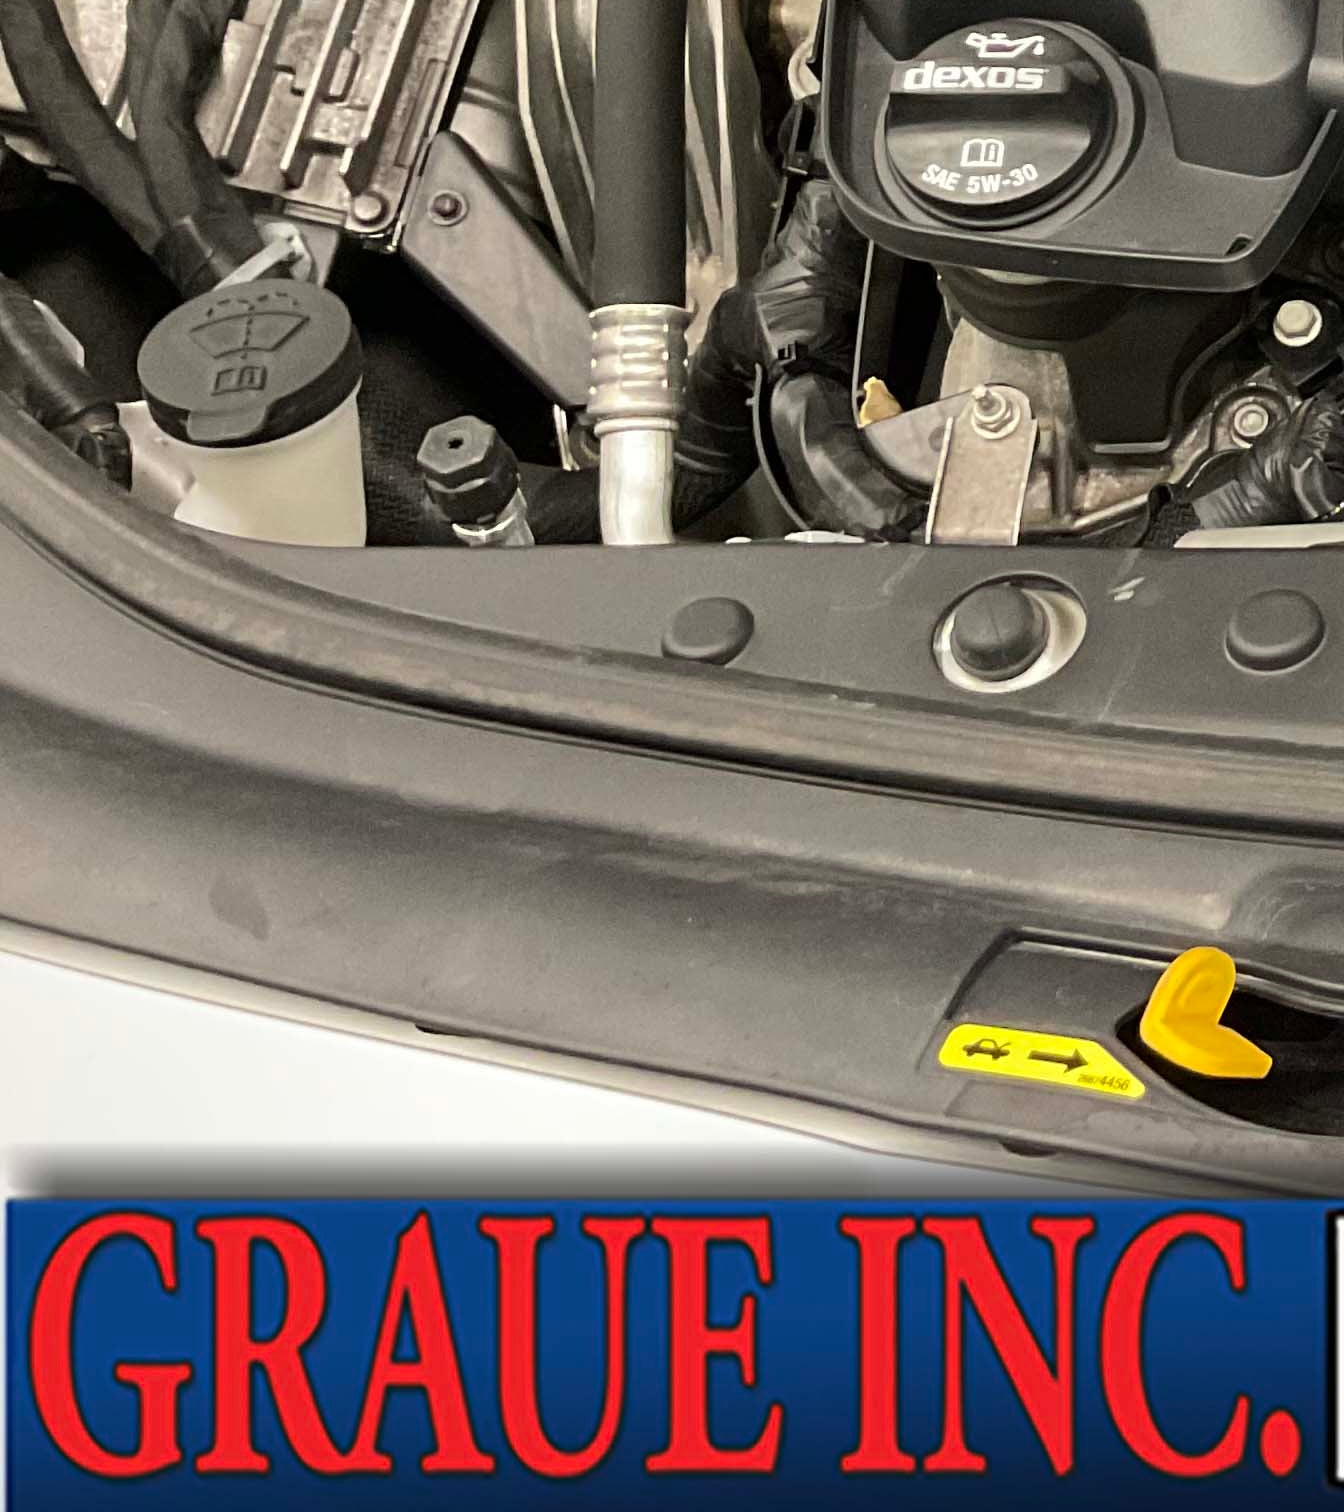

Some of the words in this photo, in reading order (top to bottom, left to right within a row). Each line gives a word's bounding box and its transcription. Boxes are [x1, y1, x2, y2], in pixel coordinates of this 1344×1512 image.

[904, 61, 1048, 90] dexos
[921, 164, 961, 191] SAE
[966, 164, 1039, 194] 5W-30
